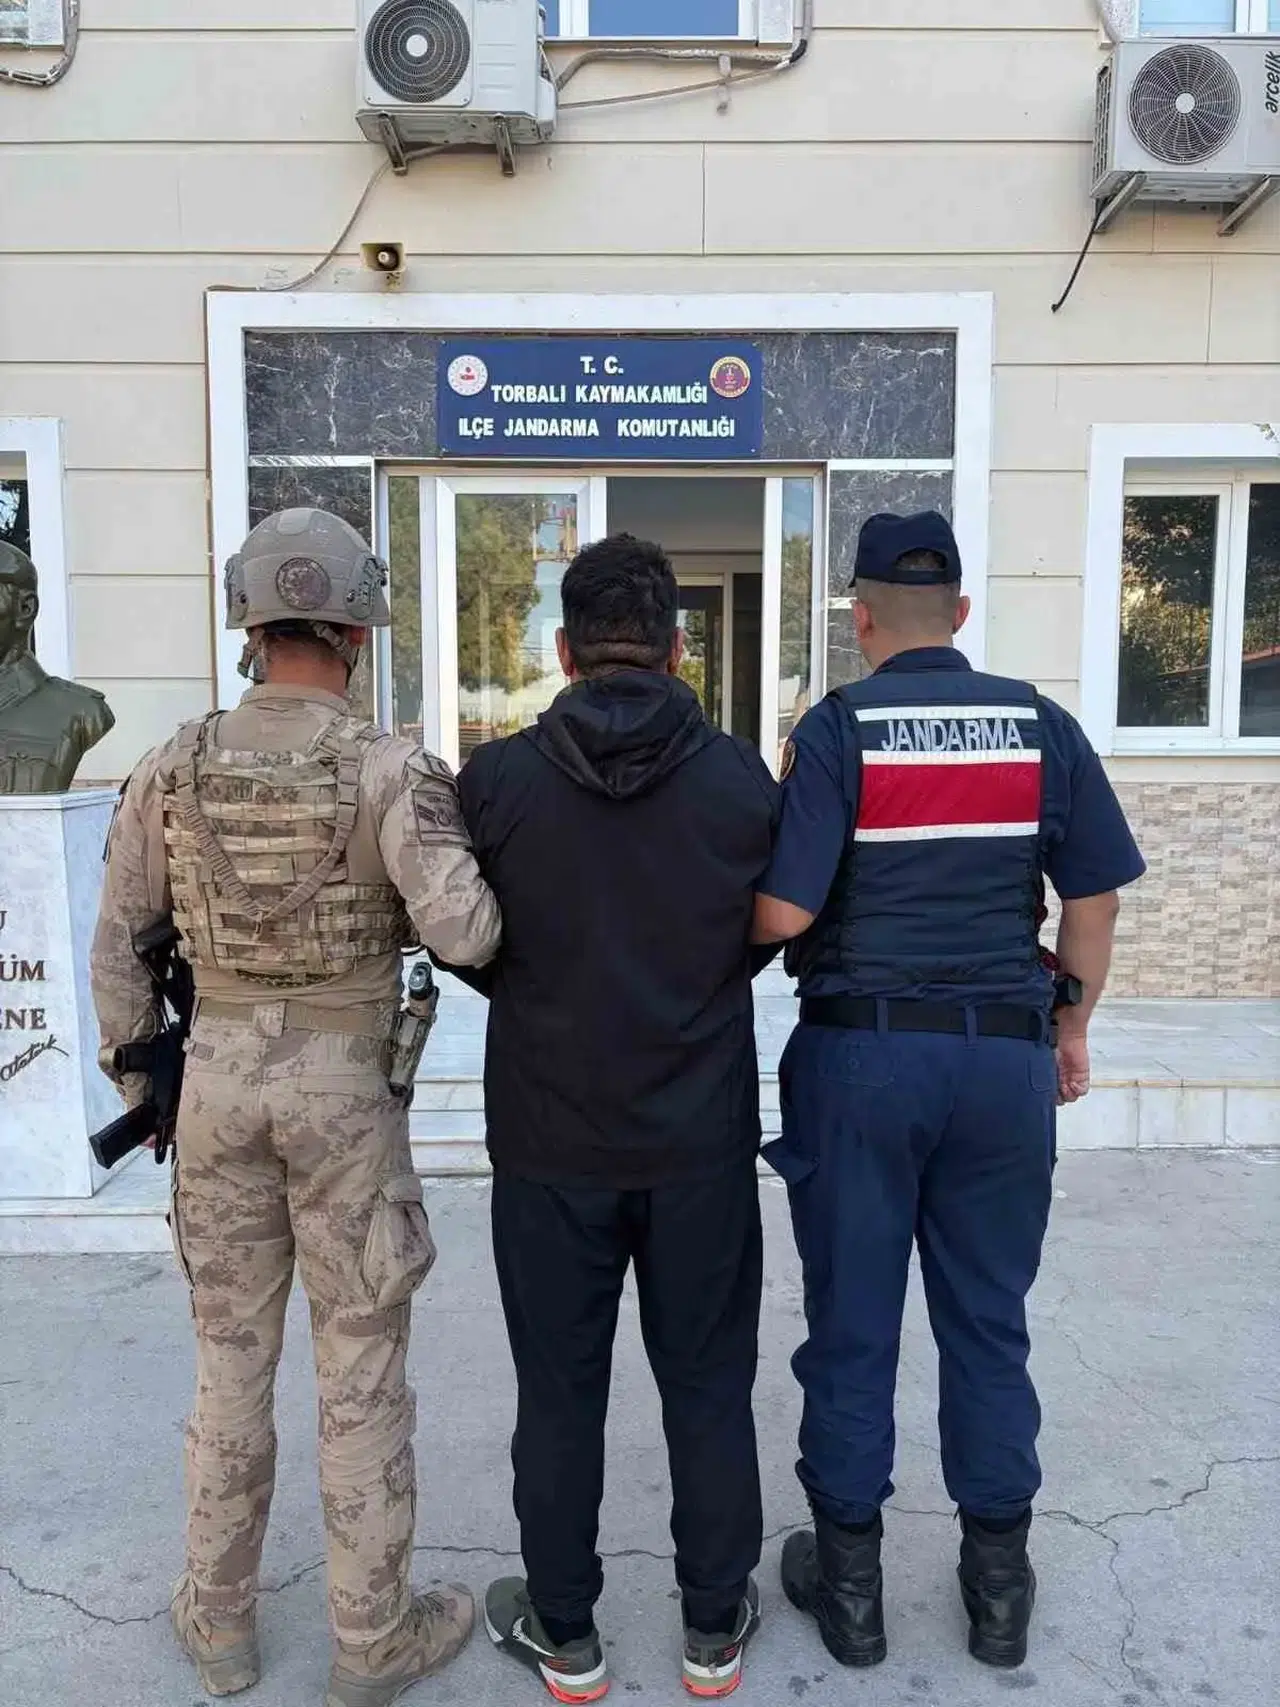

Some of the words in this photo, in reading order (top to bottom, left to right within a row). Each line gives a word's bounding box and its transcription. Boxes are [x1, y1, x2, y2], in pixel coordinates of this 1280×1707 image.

[580, 356, 596, 374] T.
[604, 356, 624, 374] C.
[491, 385, 566, 403] TORBALI
[575, 381, 707, 404] KAYMAKAMLIĞI
[504, 418, 599, 437] JANDARMA
[617, 416, 735, 437] KOMUTANLIĞI
[881, 718, 1024, 751] JANDARMA
[0, 1008, 47, 1030] NE
